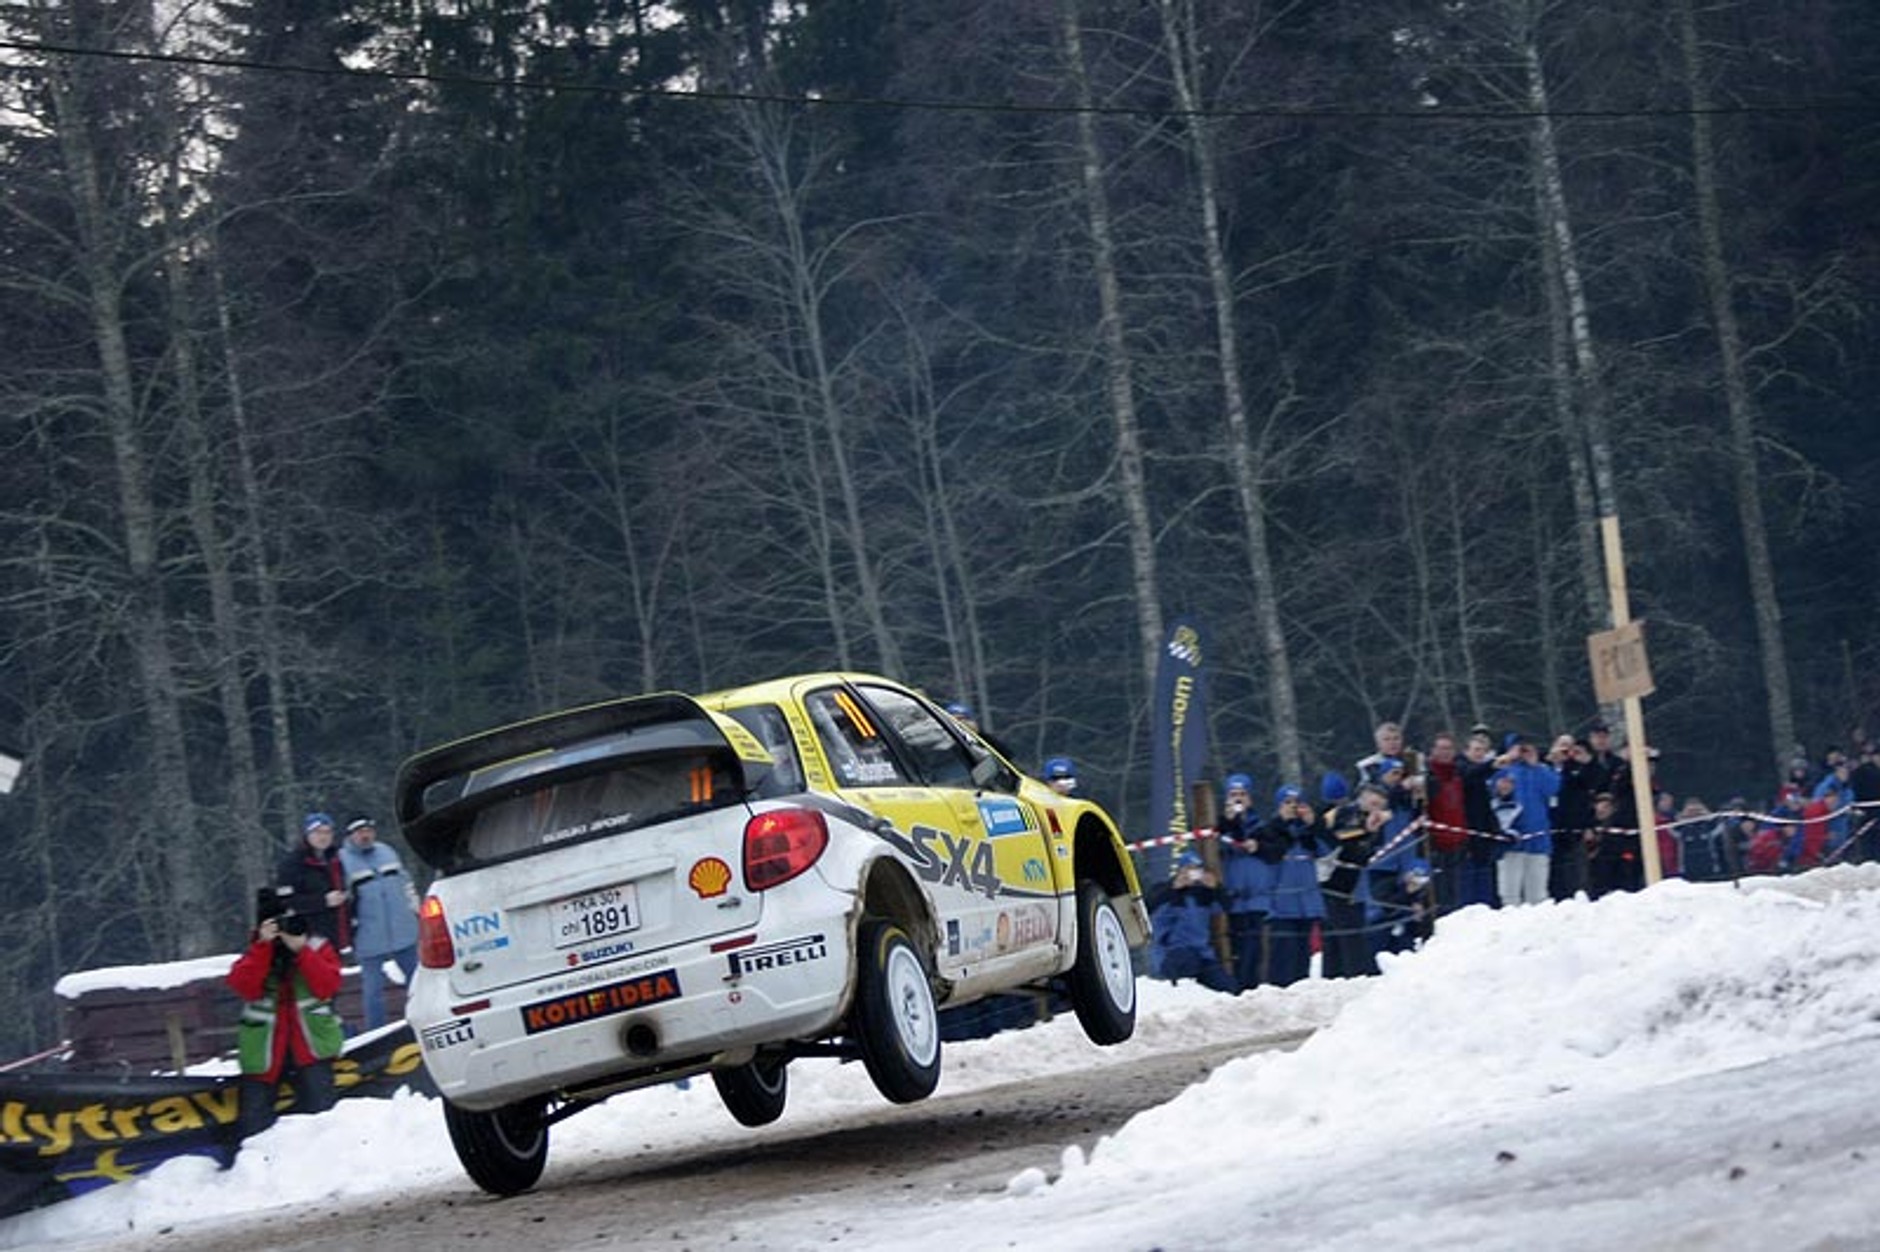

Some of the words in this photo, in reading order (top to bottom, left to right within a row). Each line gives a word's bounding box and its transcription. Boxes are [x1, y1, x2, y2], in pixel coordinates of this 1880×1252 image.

[690, 766, 712, 803] 11
[912, 825, 1001, 901] SX4
[454, 911, 500, 939] NTN
[581, 903, 632, 937] 1891
[583, 941, 634, 962] SUZUKI
[721, 934, 827, 981] PIRELLI
[526, 991, 590, 1029] KOTI
[610, 976, 674, 1008] IDEA
